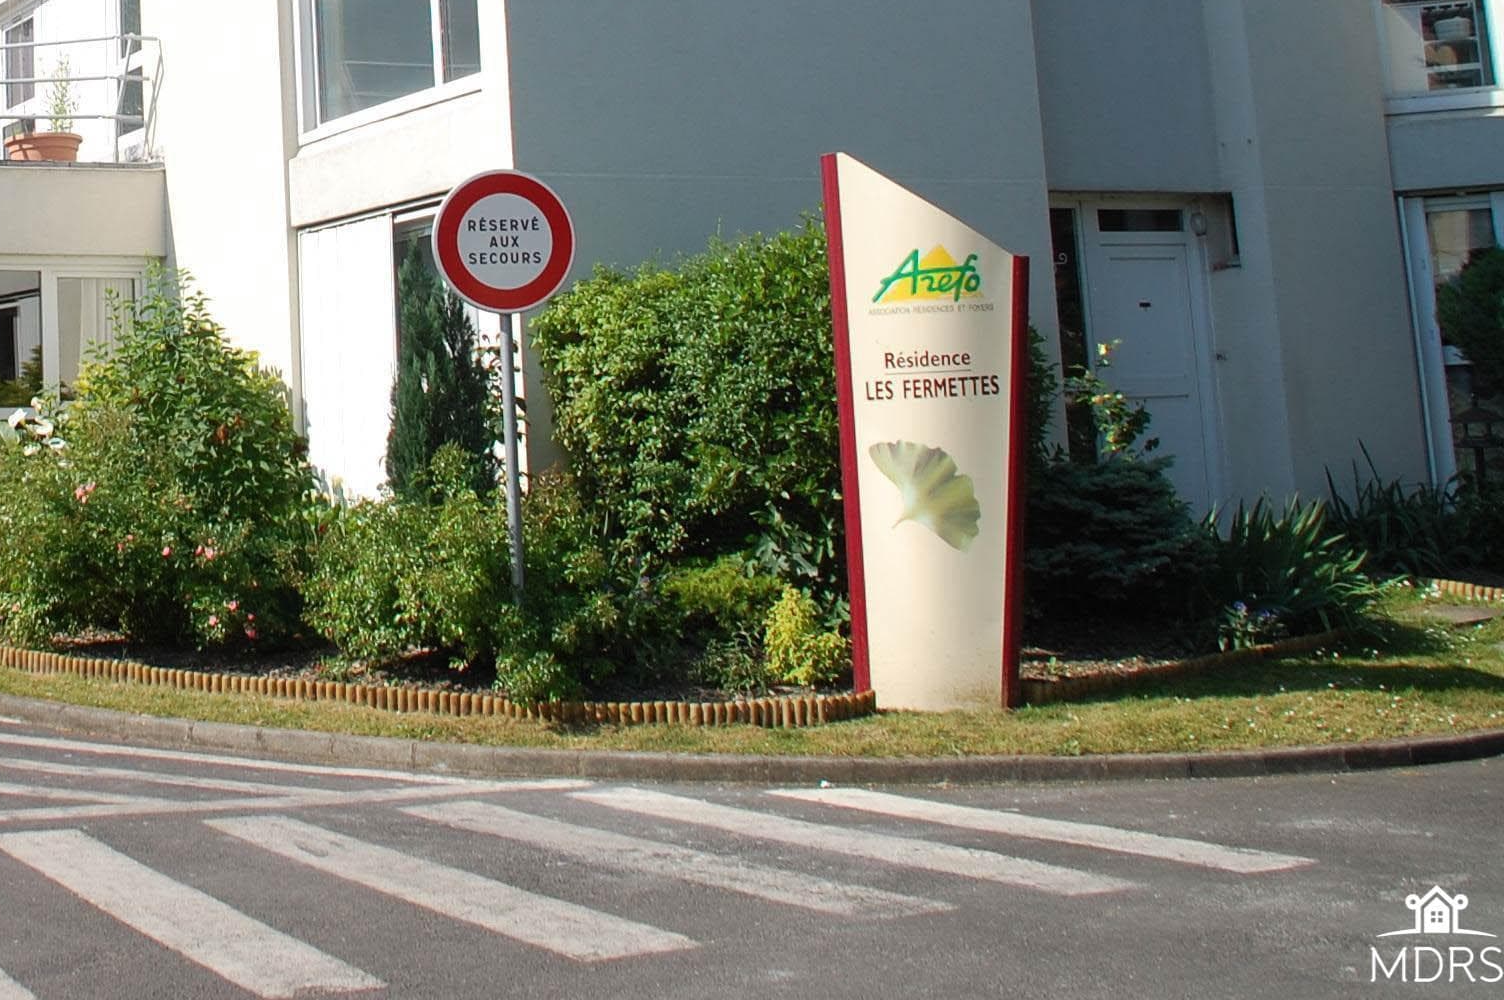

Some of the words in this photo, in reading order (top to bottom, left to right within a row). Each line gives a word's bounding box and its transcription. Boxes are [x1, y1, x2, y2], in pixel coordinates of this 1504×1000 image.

[467, 216, 540, 232] RÉSERVÉ
[489, 236, 520, 248] AUX
[468, 251, 542, 265] SECOURS
[884, 350, 971, 369] Résidence
[865, 380, 894, 401] LES
[903, 375, 1000, 399] FERMETTES
